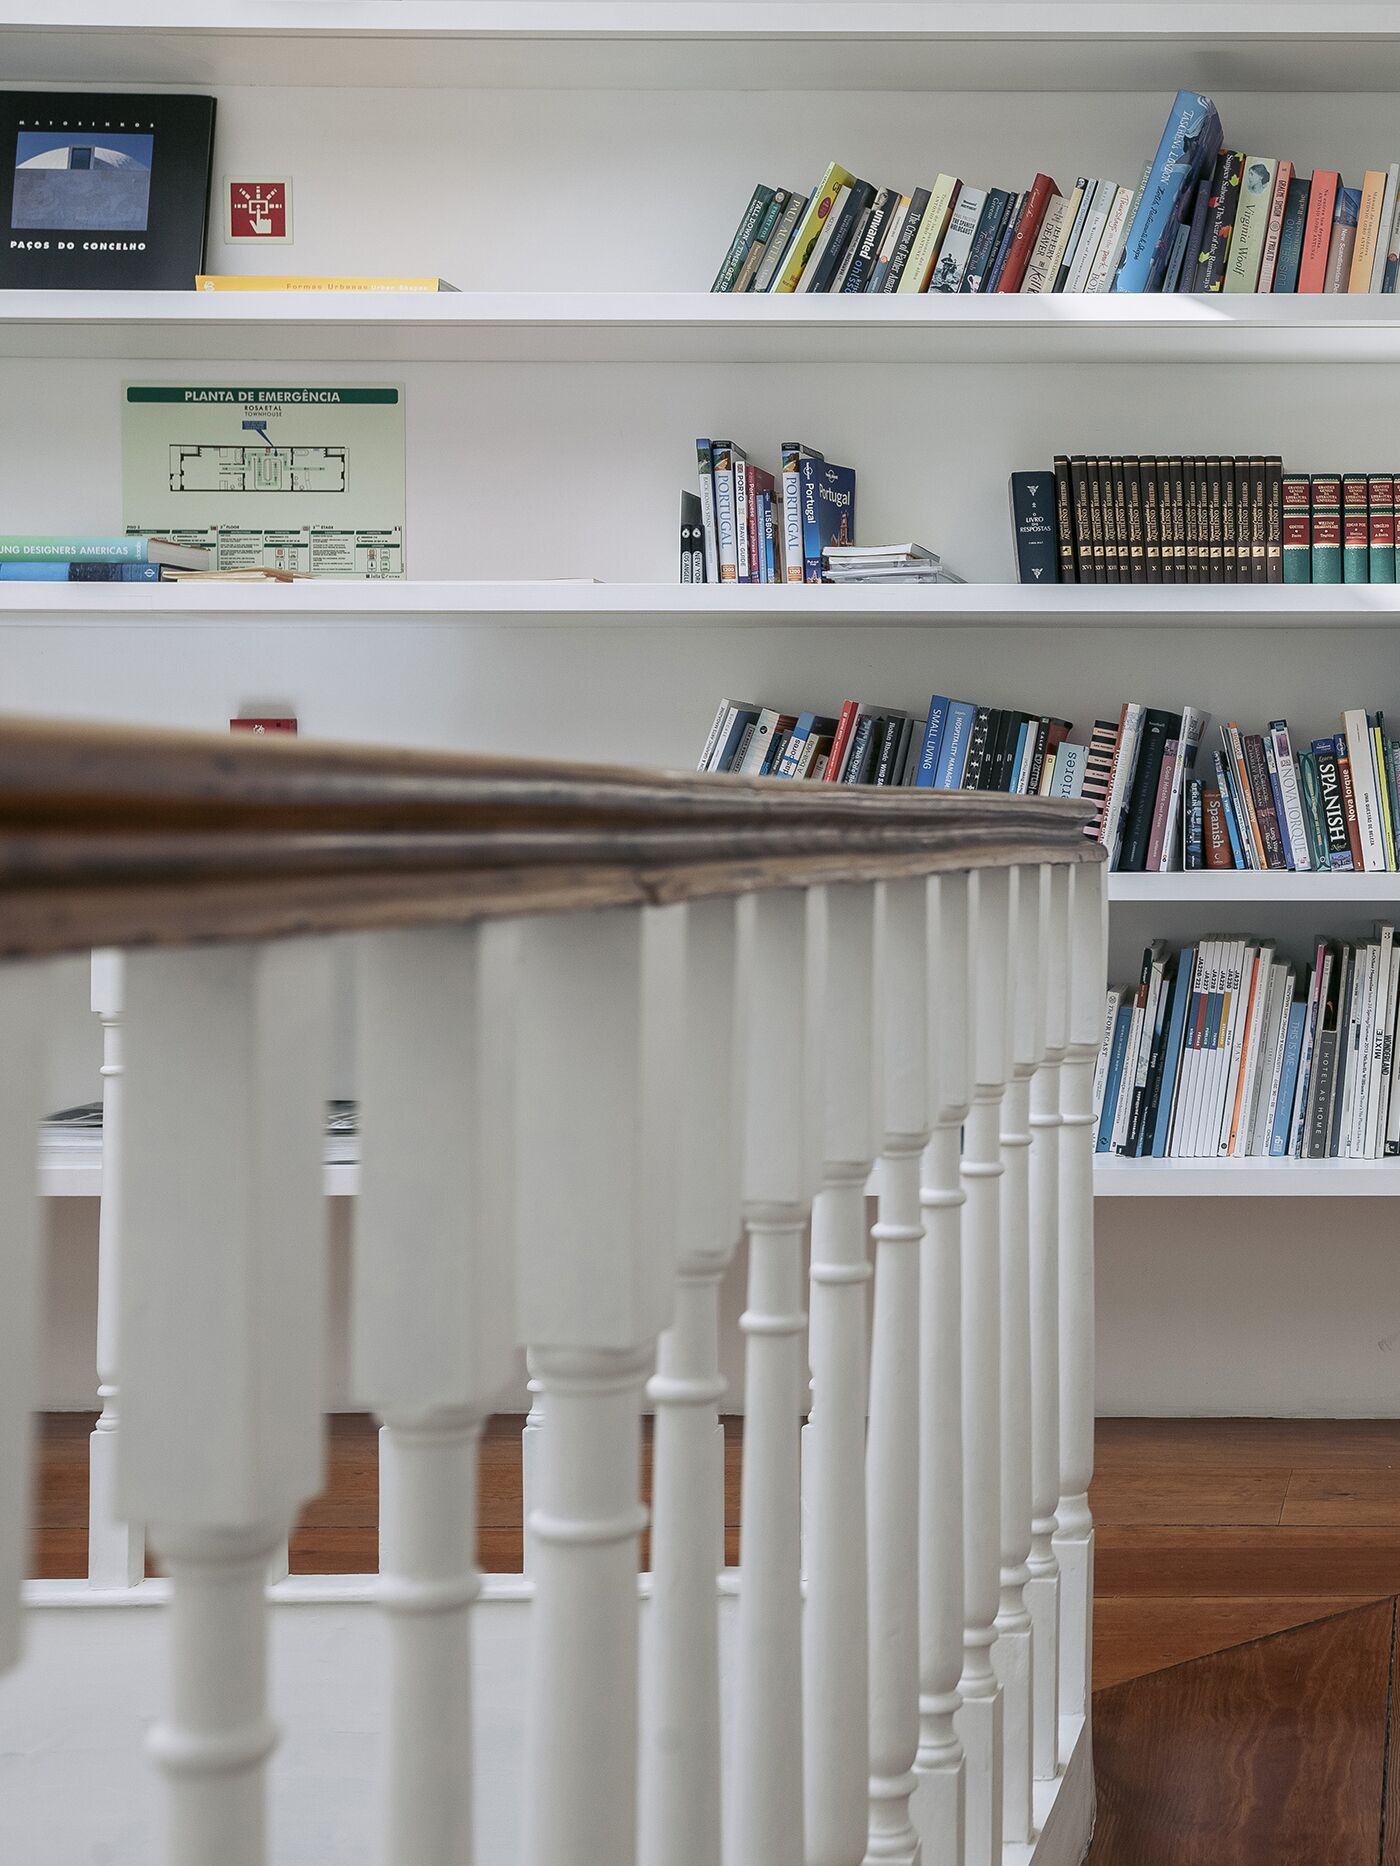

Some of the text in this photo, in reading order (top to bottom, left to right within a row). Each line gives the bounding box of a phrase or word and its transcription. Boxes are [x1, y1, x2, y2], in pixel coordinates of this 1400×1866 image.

[18, 120, 155, 129] MATOSINHOS
[1158, 150, 1179, 185] LONDON
[958, 218, 975, 229] SPANISH
[985, 196, 1000, 221] Greene
[1200, 153, 1234, 289] Sunjeev Year of the Runaways
[764, 198, 802, 265] PAUL AUSTER
[858, 208, 887, 260] unwanted
[890, 210, 922, 273] The Crime of Father
[949, 222, 973, 236] HOLOCAUST
[1033, 221, 1056, 258] DEAVER
[1043, 225, 1064, 260] JEFFERY
[1231, 203, 1256, 277] Virginia Woolf
[1280, 217, 1294, 262] SELLANO
[10, 240, 146, 252] PAÇOS DO CONCELHO
[718, 199, 764, 291] FALL DOWN TIMES GET UP
[968, 229, 987, 271] Teacup Club
[978, 234, 993, 260] Vintage
[1097, 249, 1110, 268] park
[1333, 228, 1348, 282] New Scandinavian
[286, 283, 322, 291] Formas
[184, 388, 341, 403] PLANTA DE EMERGÊNCIA
[736, 474, 744, 502] PORTO
[747, 482, 756, 517] Portuguese
[803, 482, 816, 523] Portugal
[819, 483, 851, 507] Portugal
[1148, 481, 1156, 508] RIBEIRO
[716, 474, 733, 549] PORTUGAL
[764, 509, 772, 539] LISBON
[785, 476, 799, 551] PORTUGAL
[23, 545, 76, 555] DESIGNERS
[79, 546, 129, 556] AMERICAS
[712, 706, 725, 730] MAGAZINE
[885, 721, 896, 741] Robin
[880, 740, 892, 762] Rhode
[921, 708, 943, 770] SMALL LIVING
[949, 716, 963, 756] HOSPITALITY
[1163, 765, 1172, 781] Cool
[1160, 780, 1170, 802] Hotels
[1190, 782, 1198, 806] BERLIN
[1318, 762, 1346, 842] SPANISH
[1341, 768, 1356, 821] Nova Iorque
[1207, 799, 1225, 849] Spanish
[1280, 767, 1306, 856] NOVA IORQUE
[1363, 802, 1373, 823] QUESTÃO
[1268, 826, 1279, 853] Long Way
[1367, 829, 1375, 846] BELEZA
[1202, 970, 1210, 990] JA227
[1209, 968, 1218, 989] JA228
[1225, 968, 1233, 989] JA230
[1367, 968, 1375, 991] Magazine
[1100, 1005, 1114, 1057] The FORECAST
[1285, 1021, 1299, 1066] THIS IS ME
[1372, 1028, 1384, 1060] MIXTE
[1232, 1041, 1243, 1063] MAN
[1380, 1033, 1392, 1076] WONDERLAND
[1314, 1051, 1330, 1134] HOTEL AS HOME
